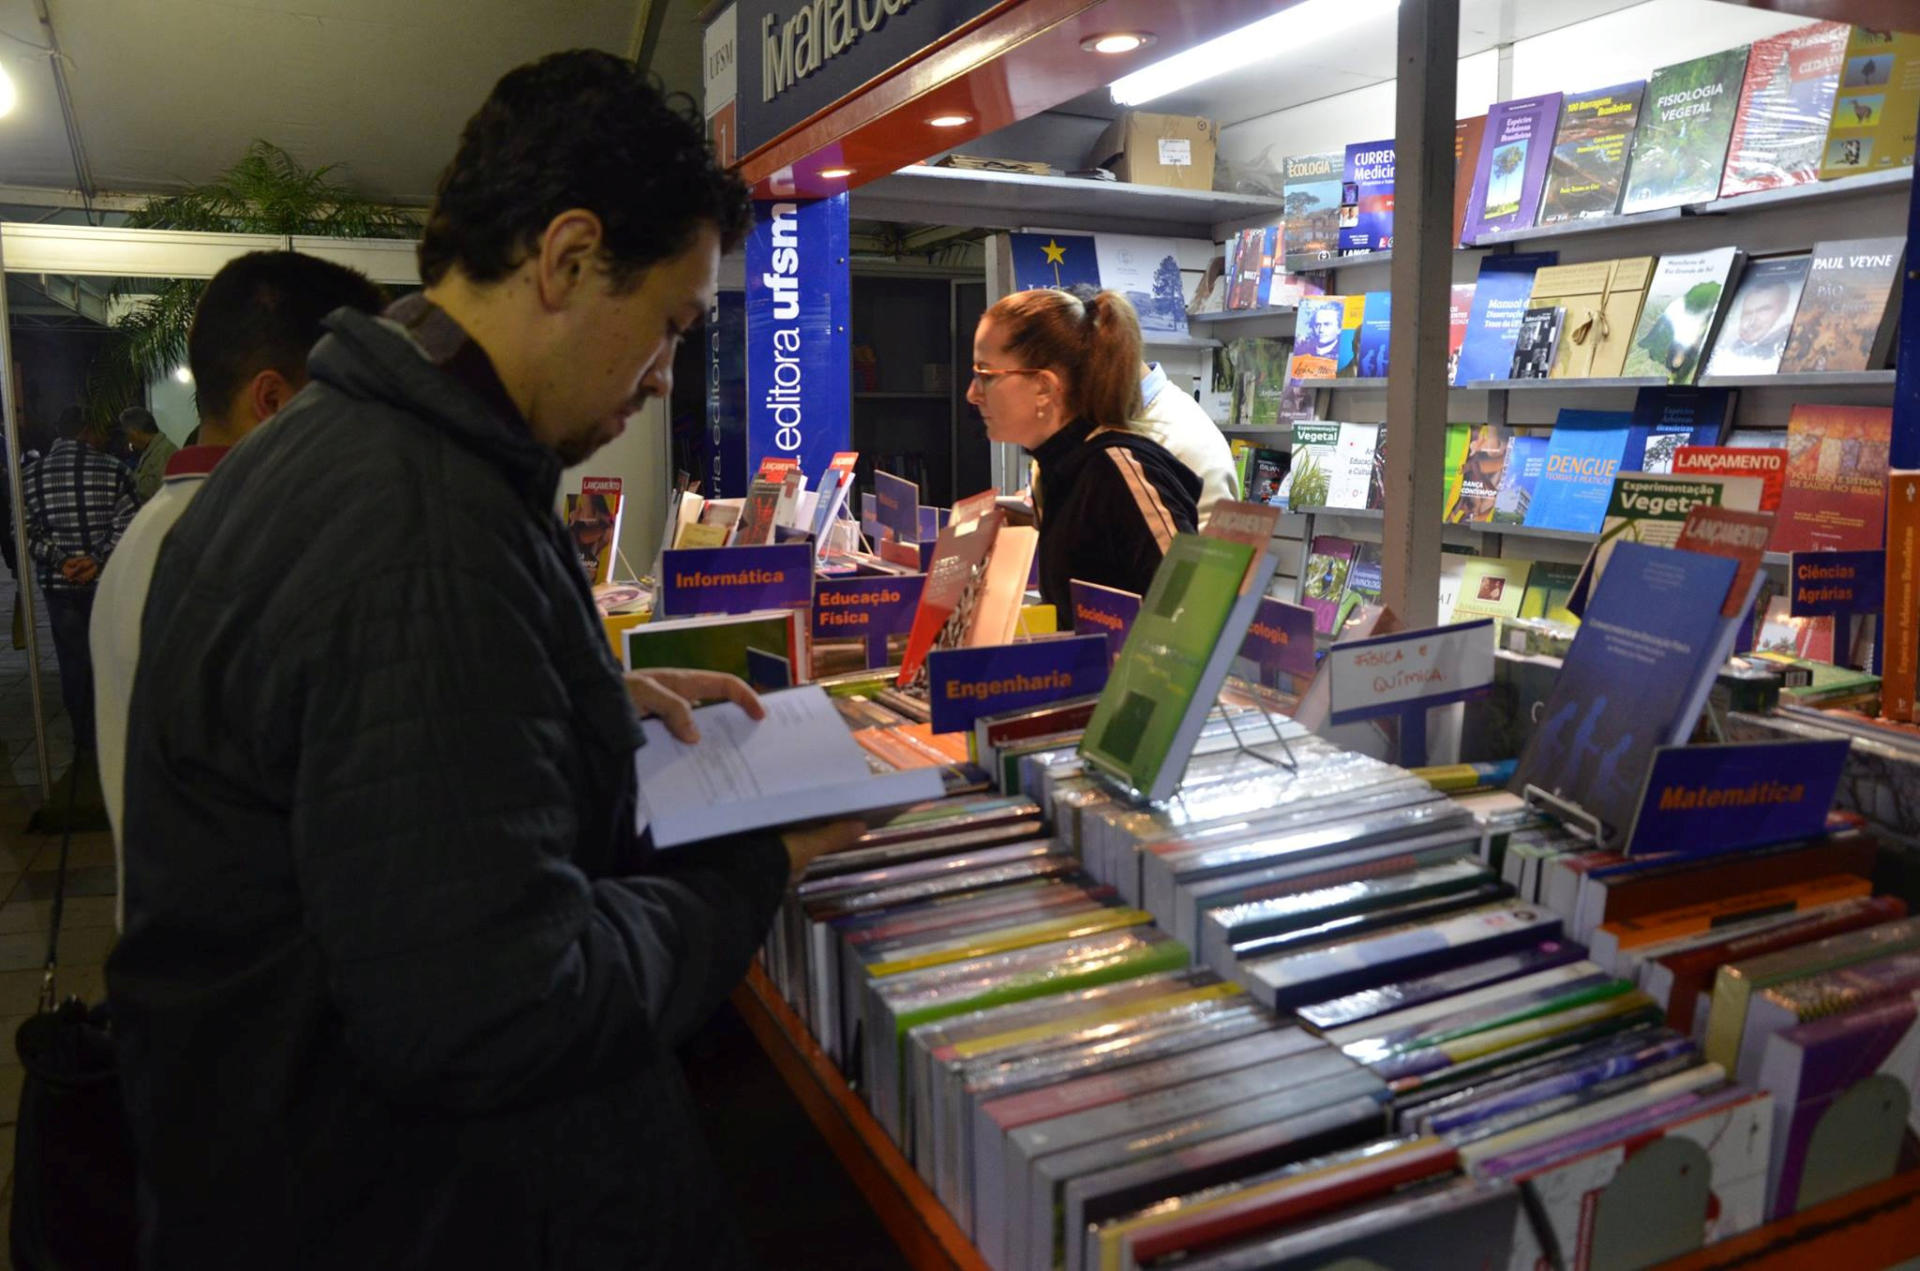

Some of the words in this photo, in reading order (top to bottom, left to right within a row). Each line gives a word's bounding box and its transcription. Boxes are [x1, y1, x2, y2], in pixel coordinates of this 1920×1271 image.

[1657, 83, 1723, 108] FISIOLOGIA
[1662, 102, 1712, 121] VEGETAL
[1289, 160, 1330, 178] ECOLOGIA
[763, 203, 800, 320] ufsm
[1812, 257, 1844, 270] PAUL
[1850, 255, 1893, 268] VEYNE
[766, 327, 801, 451] editora
[1297, 431, 1338, 442] Vegetal
[1547, 455, 1618, 478] DENGUE
[1678, 454, 1781, 470] LANÇAMENTO
[583, 482, 620, 491] LANÇAMENTO
[1623, 482, 1715, 496] Experimentação
[676, 569, 785, 588] Informática
[1797, 564, 1855, 579] Ciências
[819, 590, 901, 607] Educação
[1798, 587, 1853, 603] Agrárias
[819, 611, 869, 626] Física
[1076, 603, 1124, 631] Sociologia
[946, 669, 1072, 699] Engenharia
[1659, 780, 1805, 811] Matemática
